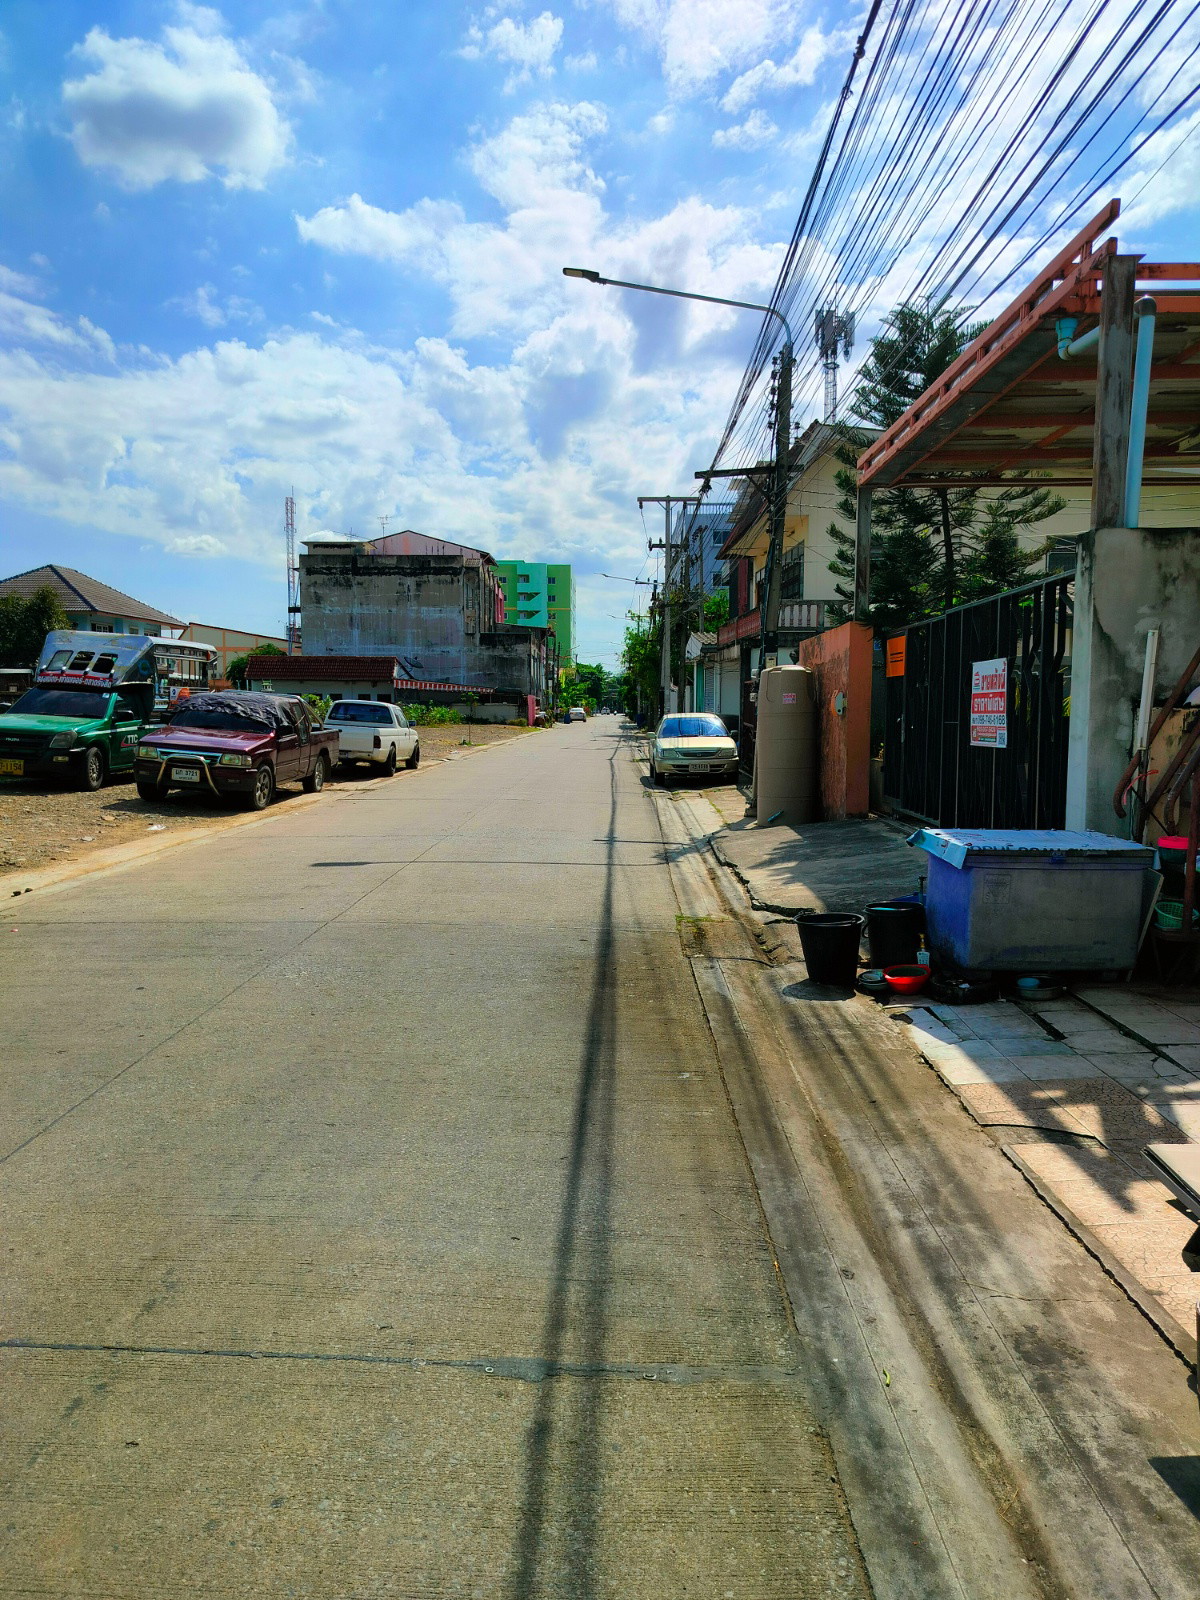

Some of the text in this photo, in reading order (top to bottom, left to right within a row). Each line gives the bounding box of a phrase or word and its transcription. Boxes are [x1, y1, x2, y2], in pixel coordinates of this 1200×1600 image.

[974, 694, 1004, 711] ราคาพิเศษ
[127, 734, 139, 744] TTC
